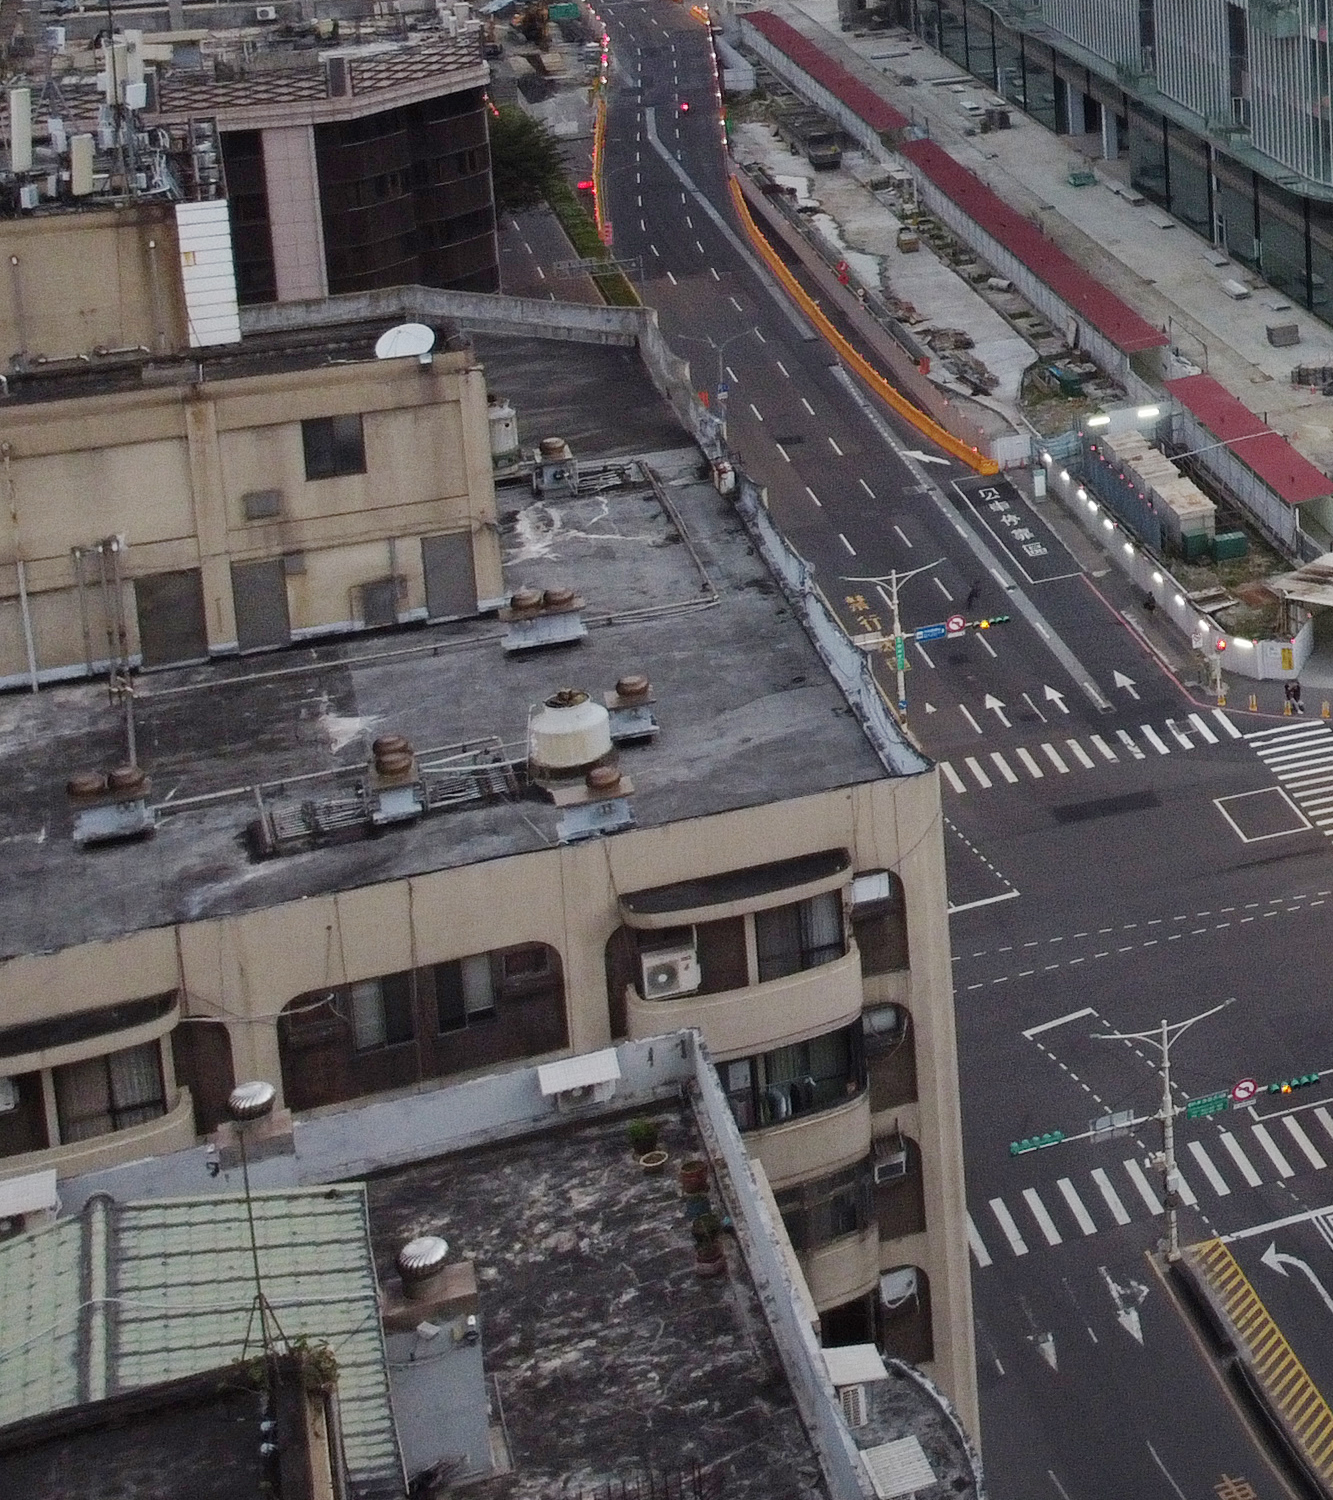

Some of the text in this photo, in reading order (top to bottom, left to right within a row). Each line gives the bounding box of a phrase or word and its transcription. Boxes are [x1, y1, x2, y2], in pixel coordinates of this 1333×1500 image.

[979, 487, 1048, 557] 公車停靠區
